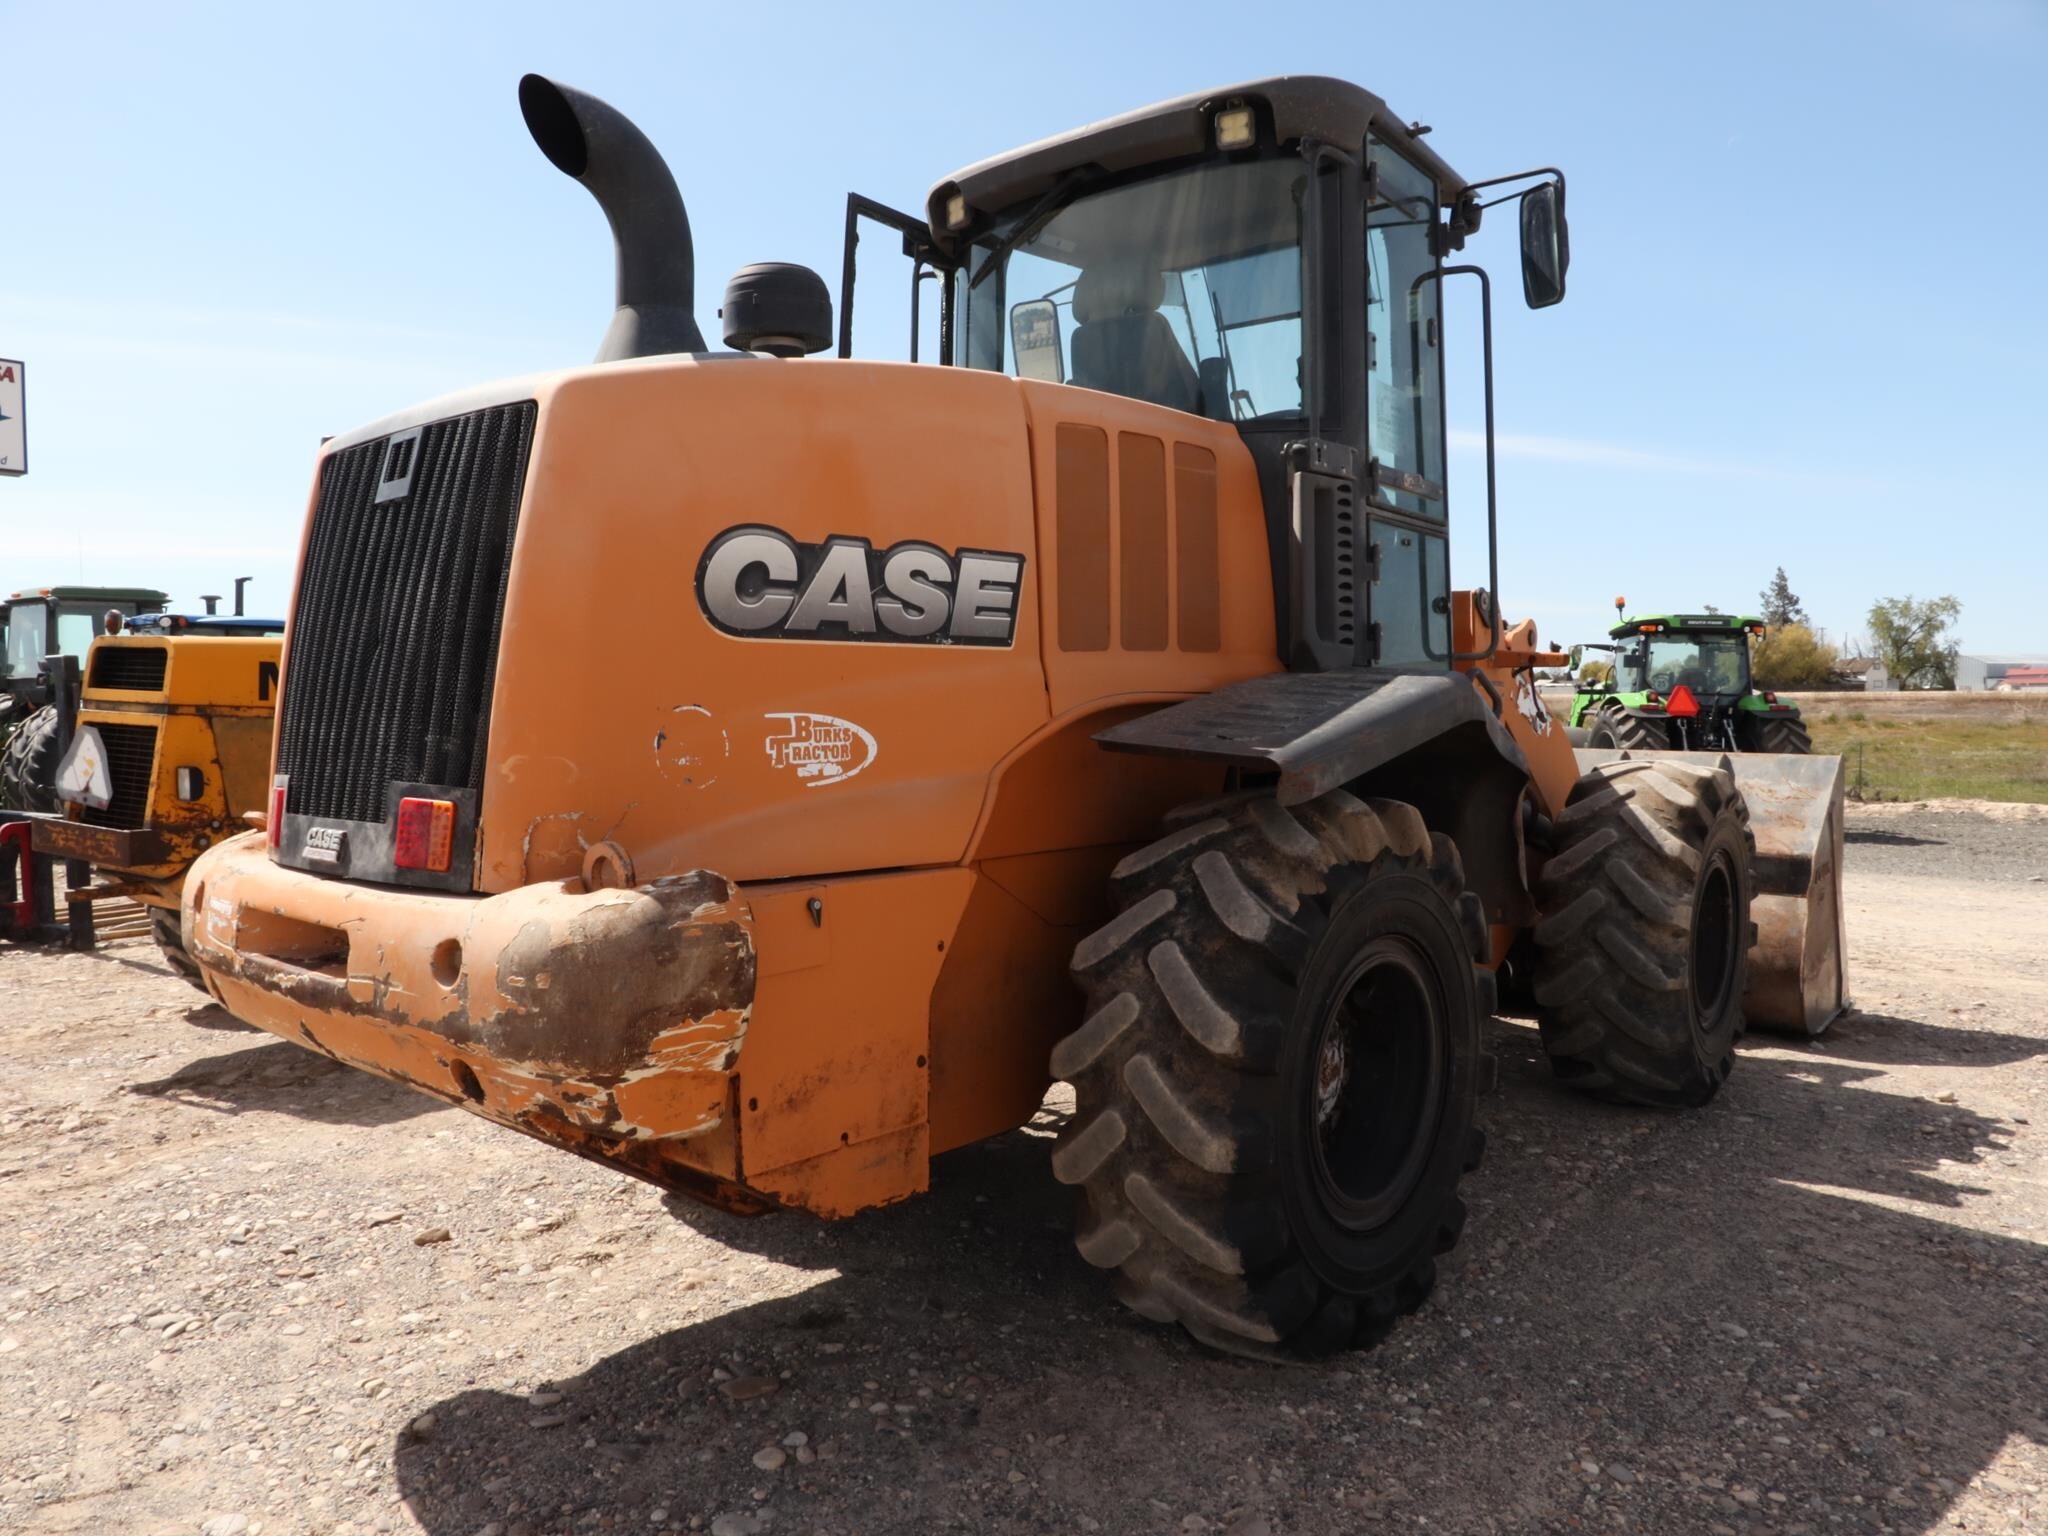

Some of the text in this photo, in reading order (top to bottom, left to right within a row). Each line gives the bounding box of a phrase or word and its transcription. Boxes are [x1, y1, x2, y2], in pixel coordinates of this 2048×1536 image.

[702, 532, 1020, 638] CASE
[791, 716, 852, 743] BURKS
[767, 737, 852, 768] TRACTOR
[307, 827, 342, 850] CASE
